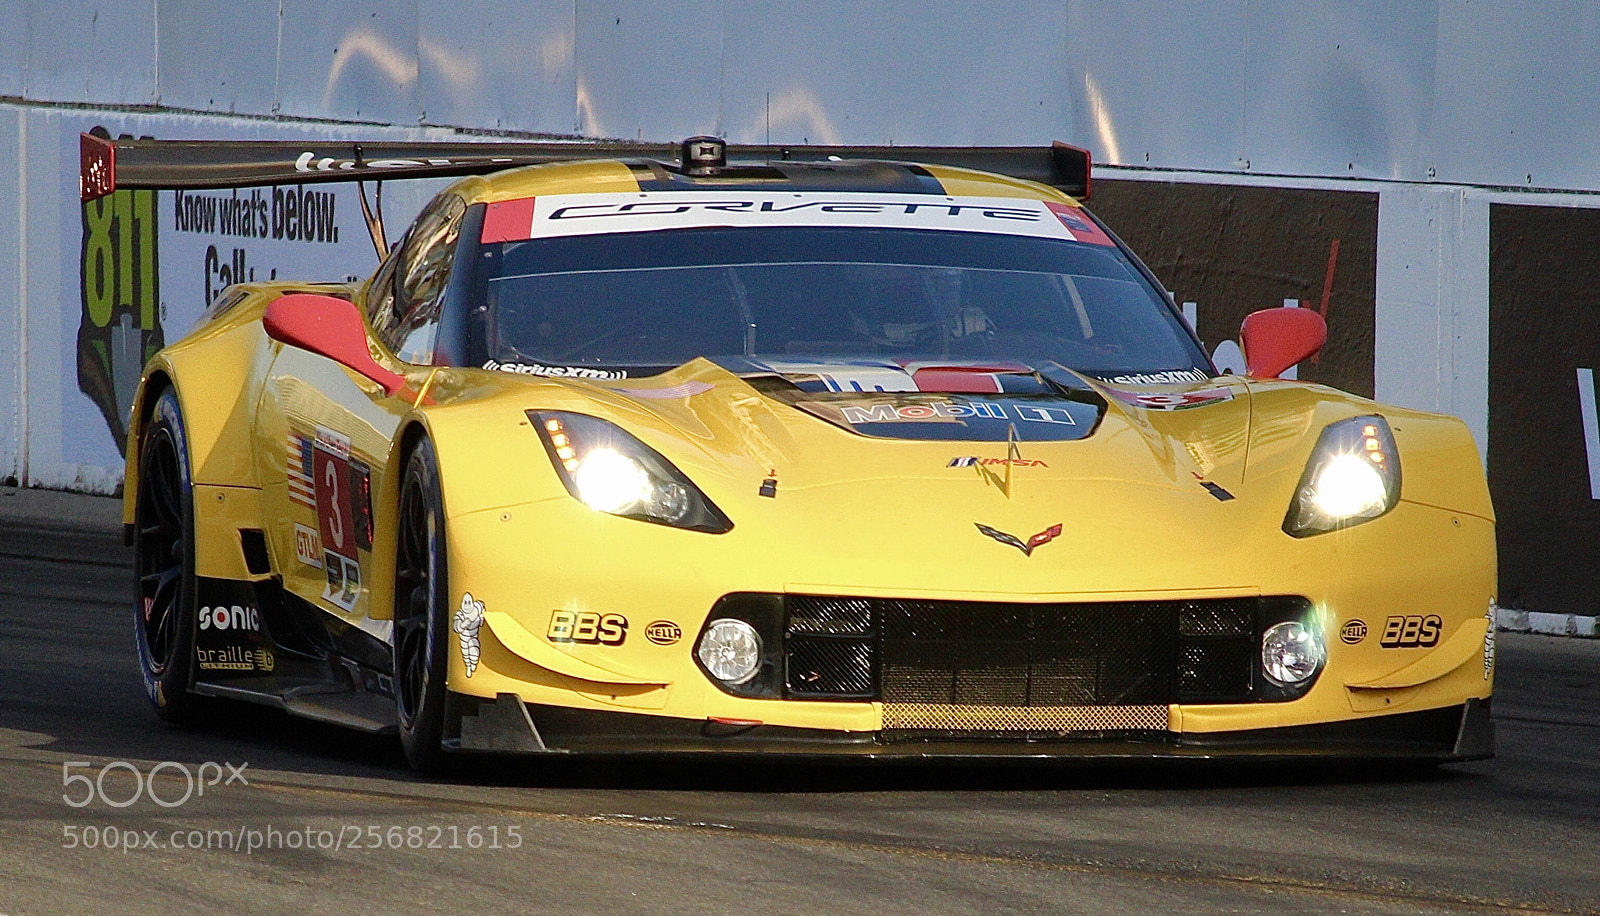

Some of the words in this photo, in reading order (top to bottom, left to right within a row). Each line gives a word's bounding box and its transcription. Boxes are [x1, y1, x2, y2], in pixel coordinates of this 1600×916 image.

[174, 188, 217, 233] Know
[218, 188, 268, 239] what's
[271, 183, 340, 244] below.
[547, 199, 1044, 222] CORVETTE
[84, 186, 157, 331] 811
[839, 402, 1008, 424] Mobil
[982, 457, 1049, 468] IMSA
[325, 459, 344, 549] 3
[547, 609, 629, 646] BBS
[647, 627, 682, 640] HELLA
[1341, 626, 1368, 638] HELLA
[1380, 614, 1443, 648] BBS
[196, 645, 254, 663] braille
